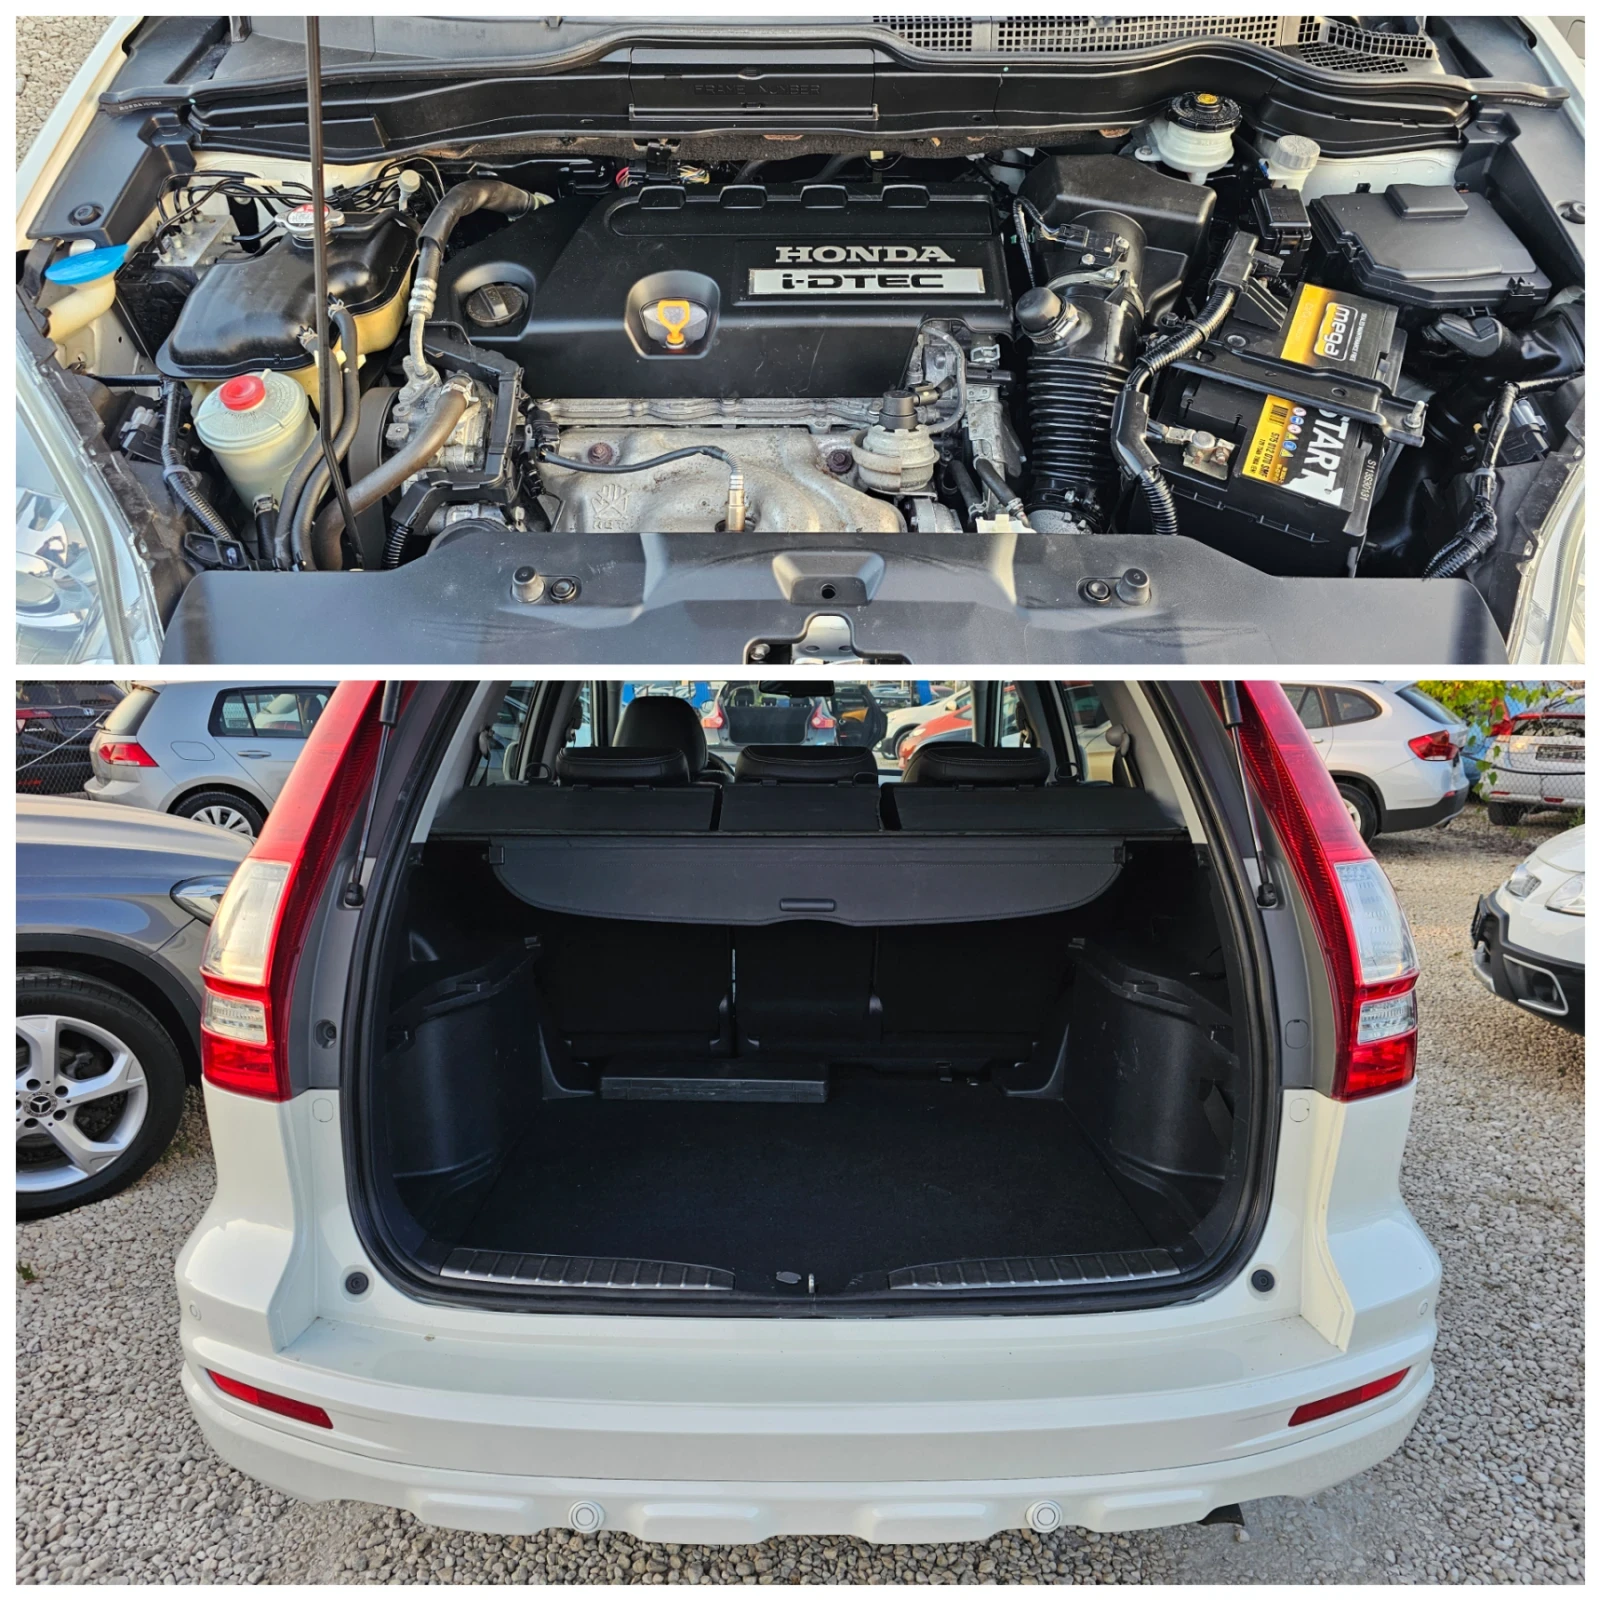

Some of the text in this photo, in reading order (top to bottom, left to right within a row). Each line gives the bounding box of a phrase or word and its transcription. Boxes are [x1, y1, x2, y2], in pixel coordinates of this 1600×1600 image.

[694, 84, 821, 95] FRAME NUMBER
[775, 245, 956, 263] HONDA
[782, 273, 944, 290] i-DTEC
[1323, 306, 1350, 356] mega
